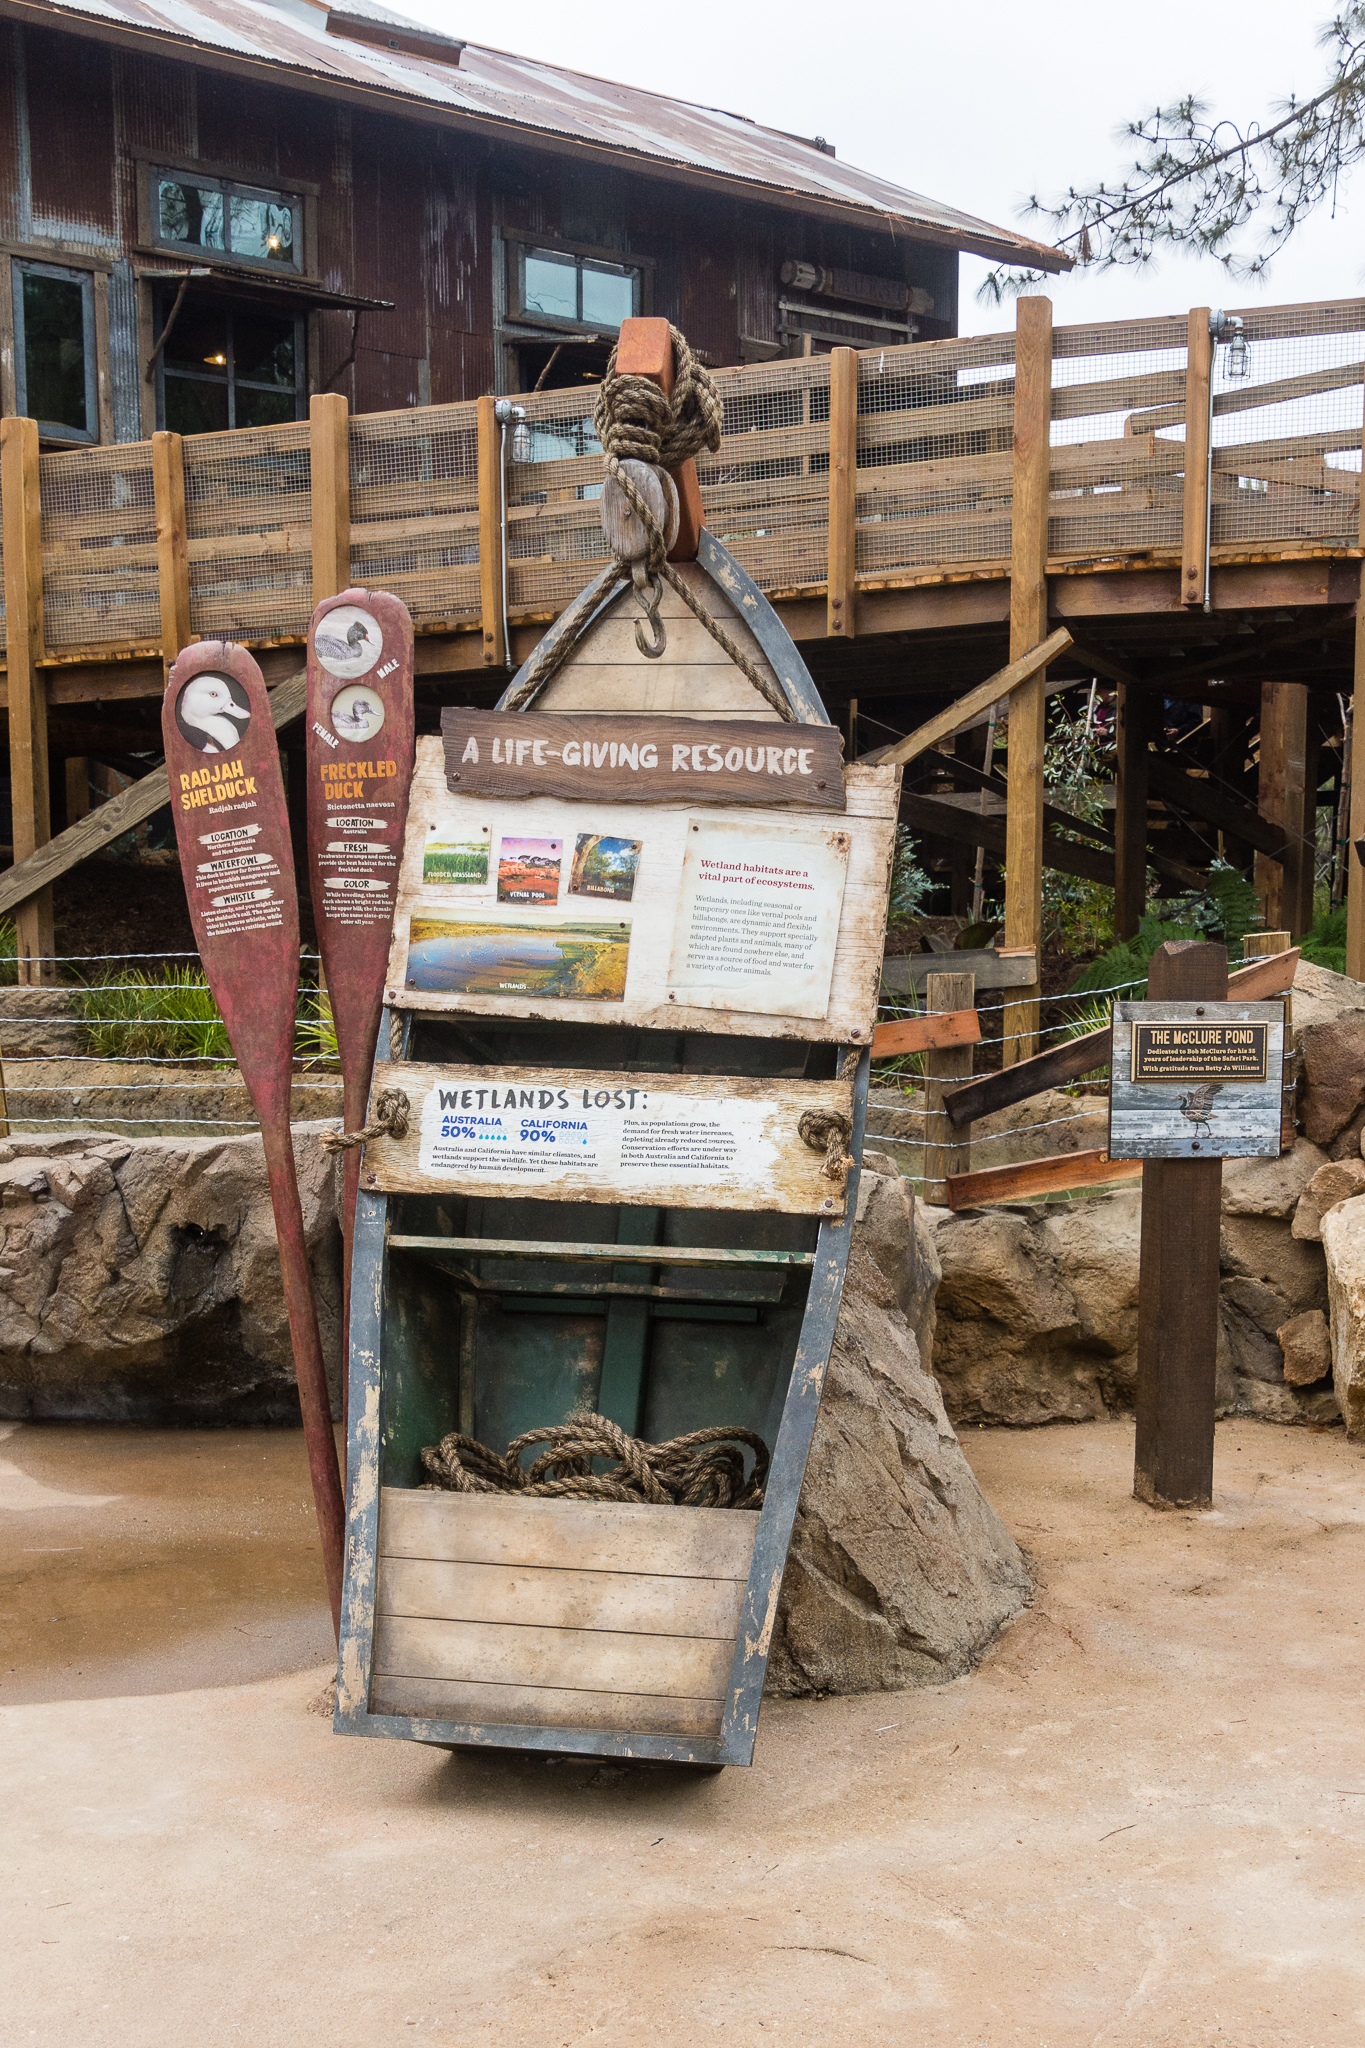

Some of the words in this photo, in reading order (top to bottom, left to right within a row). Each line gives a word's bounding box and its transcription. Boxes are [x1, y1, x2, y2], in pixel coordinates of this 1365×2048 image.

[377, 659, 400, 679] MALE
[312, 722, 339, 749] FEMALE
[461, 736, 479, 764] A
[492, 737, 658, 770] LIFE-GIVING
[672, 745, 815, 776] RESOURCE
[180, 760, 244, 790] RADJAH
[321, 761, 396, 781] FRECKLED
[181, 777, 257, 810] SHELDUCK
[325, 781, 364, 799] DUCK
[209, 804, 233, 814] Radjah
[234, 800, 257, 810] radjah
[336, 819, 373, 827] LOCATION
[211, 830, 248, 841] LOCATION
[210, 856, 258, 871] WATERFOWL
[701, 860, 741, 870] Wetland
[743, 864, 783, 874] habitats
[344, 880, 369, 888] COLOR
[699, 873, 721, 881] vital
[756, 879, 814, 890] ecosystems.
[587, 885, 614, 893] BILLABONG
[223, 892, 255, 904] WHISTLE
[696, 895, 728, 904] Wetlands,
[730, 898, 763, 908] including
[694, 905, 729, 914] temporary
[692, 914, 728, 923] billabongs,
[742, 918, 771, 927] dynamic
[787, 922, 812, 931] flexible
[690, 933, 717, 941] adapted
[754, 940, 782, 948] animals,
[691, 925, 739, 933] environments.
[741, 928, 759, 936] They
[788, 934, 818, 942] specially
[774, 950, 790, 958] else,
[1151, 1031, 1170, 1044] THE
[1174, 1030, 1222, 1044] McCLURE
[1226, 1030, 1253, 1044] POND
[439, 1089, 569, 1110] WETLANDS
[582, 1089, 648, 1110] LOST:
[442, 1116, 502, 1126] AUSTRALIA
[521, 1120, 588, 1130] CALIFORNIA
[441, 1126, 476, 1139] 50%
[520, 1130, 556, 1142] 90%
[431, 1162, 468, 1171] endangered
[502, 1165, 546, 1173] development.
